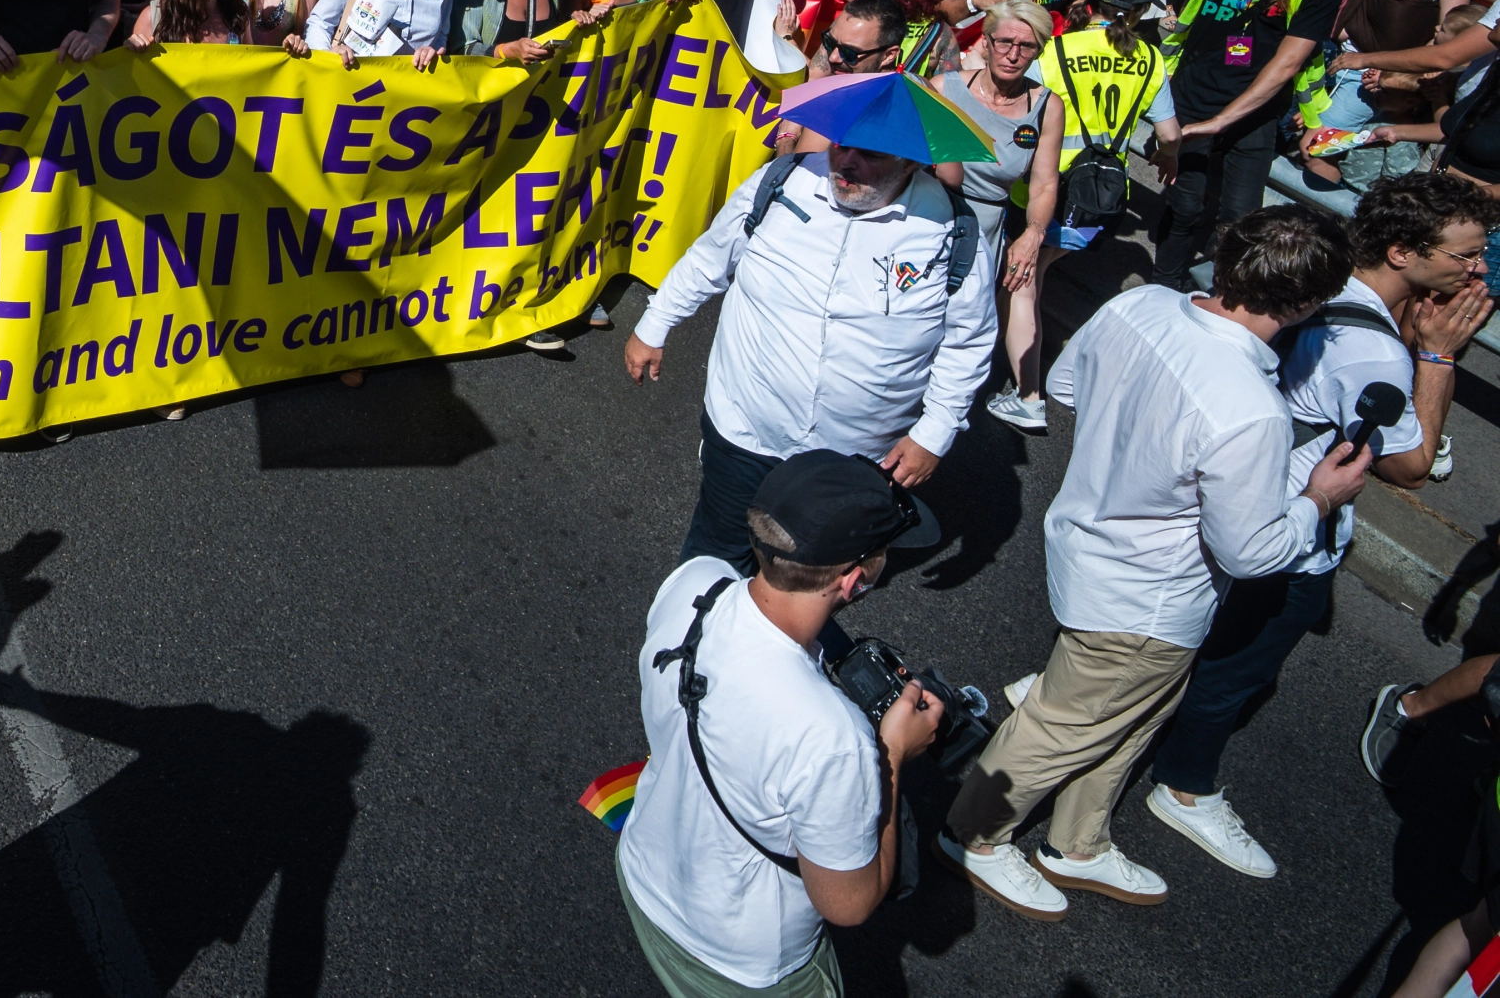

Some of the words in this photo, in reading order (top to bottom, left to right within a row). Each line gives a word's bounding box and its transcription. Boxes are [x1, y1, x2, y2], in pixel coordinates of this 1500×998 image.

[1065, 55, 1148, 79] RENDEZŐ
[1091, 82, 1120, 130] 10
[322, 78, 444, 176] ÉS
[444, 100, 503, 166] A
[267, 192, 448, 286] NEM
[32, 318, 141, 393] and
[152, 318, 268, 369] love
[282, 274, 454, 349] cannot
[468, 269, 525, 320] be
